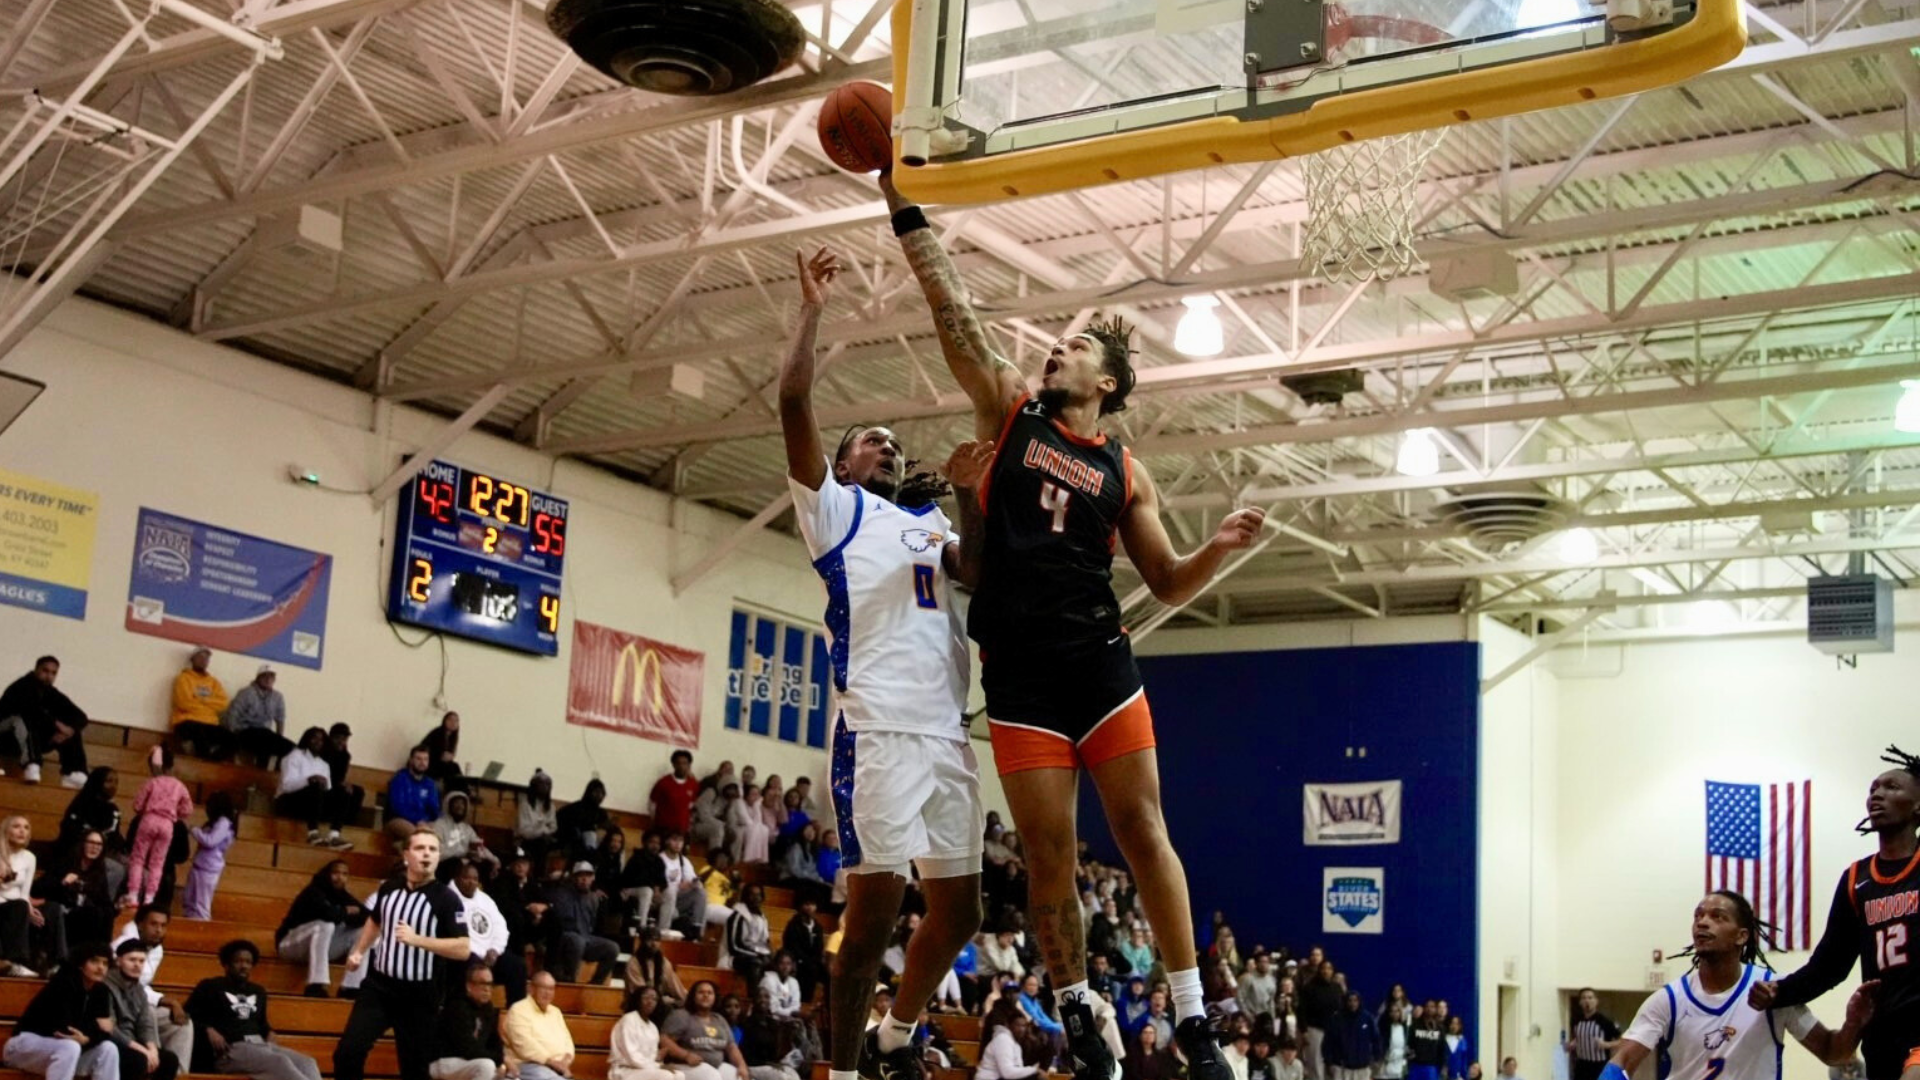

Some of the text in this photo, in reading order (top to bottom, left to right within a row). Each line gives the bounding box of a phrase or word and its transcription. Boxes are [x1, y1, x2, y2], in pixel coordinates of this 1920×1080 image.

[1023, 439, 1104, 497] UNION
[14, 487, 55, 508] EVERY
[420, 480, 453, 523] 42
[531, 496, 568, 518] GUEST
[1040, 481, 1071, 533] 4
[143, 525, 192, 560] NAIA
[483, 527, 498, 553] 2
[535, 513, 565, 556] 55
[410, 559, 433, 603] 2
[912, 563, 938, 610] 0
[540, 595, 559, 633] 4
[1318, 787, 1385, 829] NAIA
[1328, 892, 1379, 909] STATES
[1865, 890, 1919, 926] UNION
[1875, 922, 1908, 970] 12
